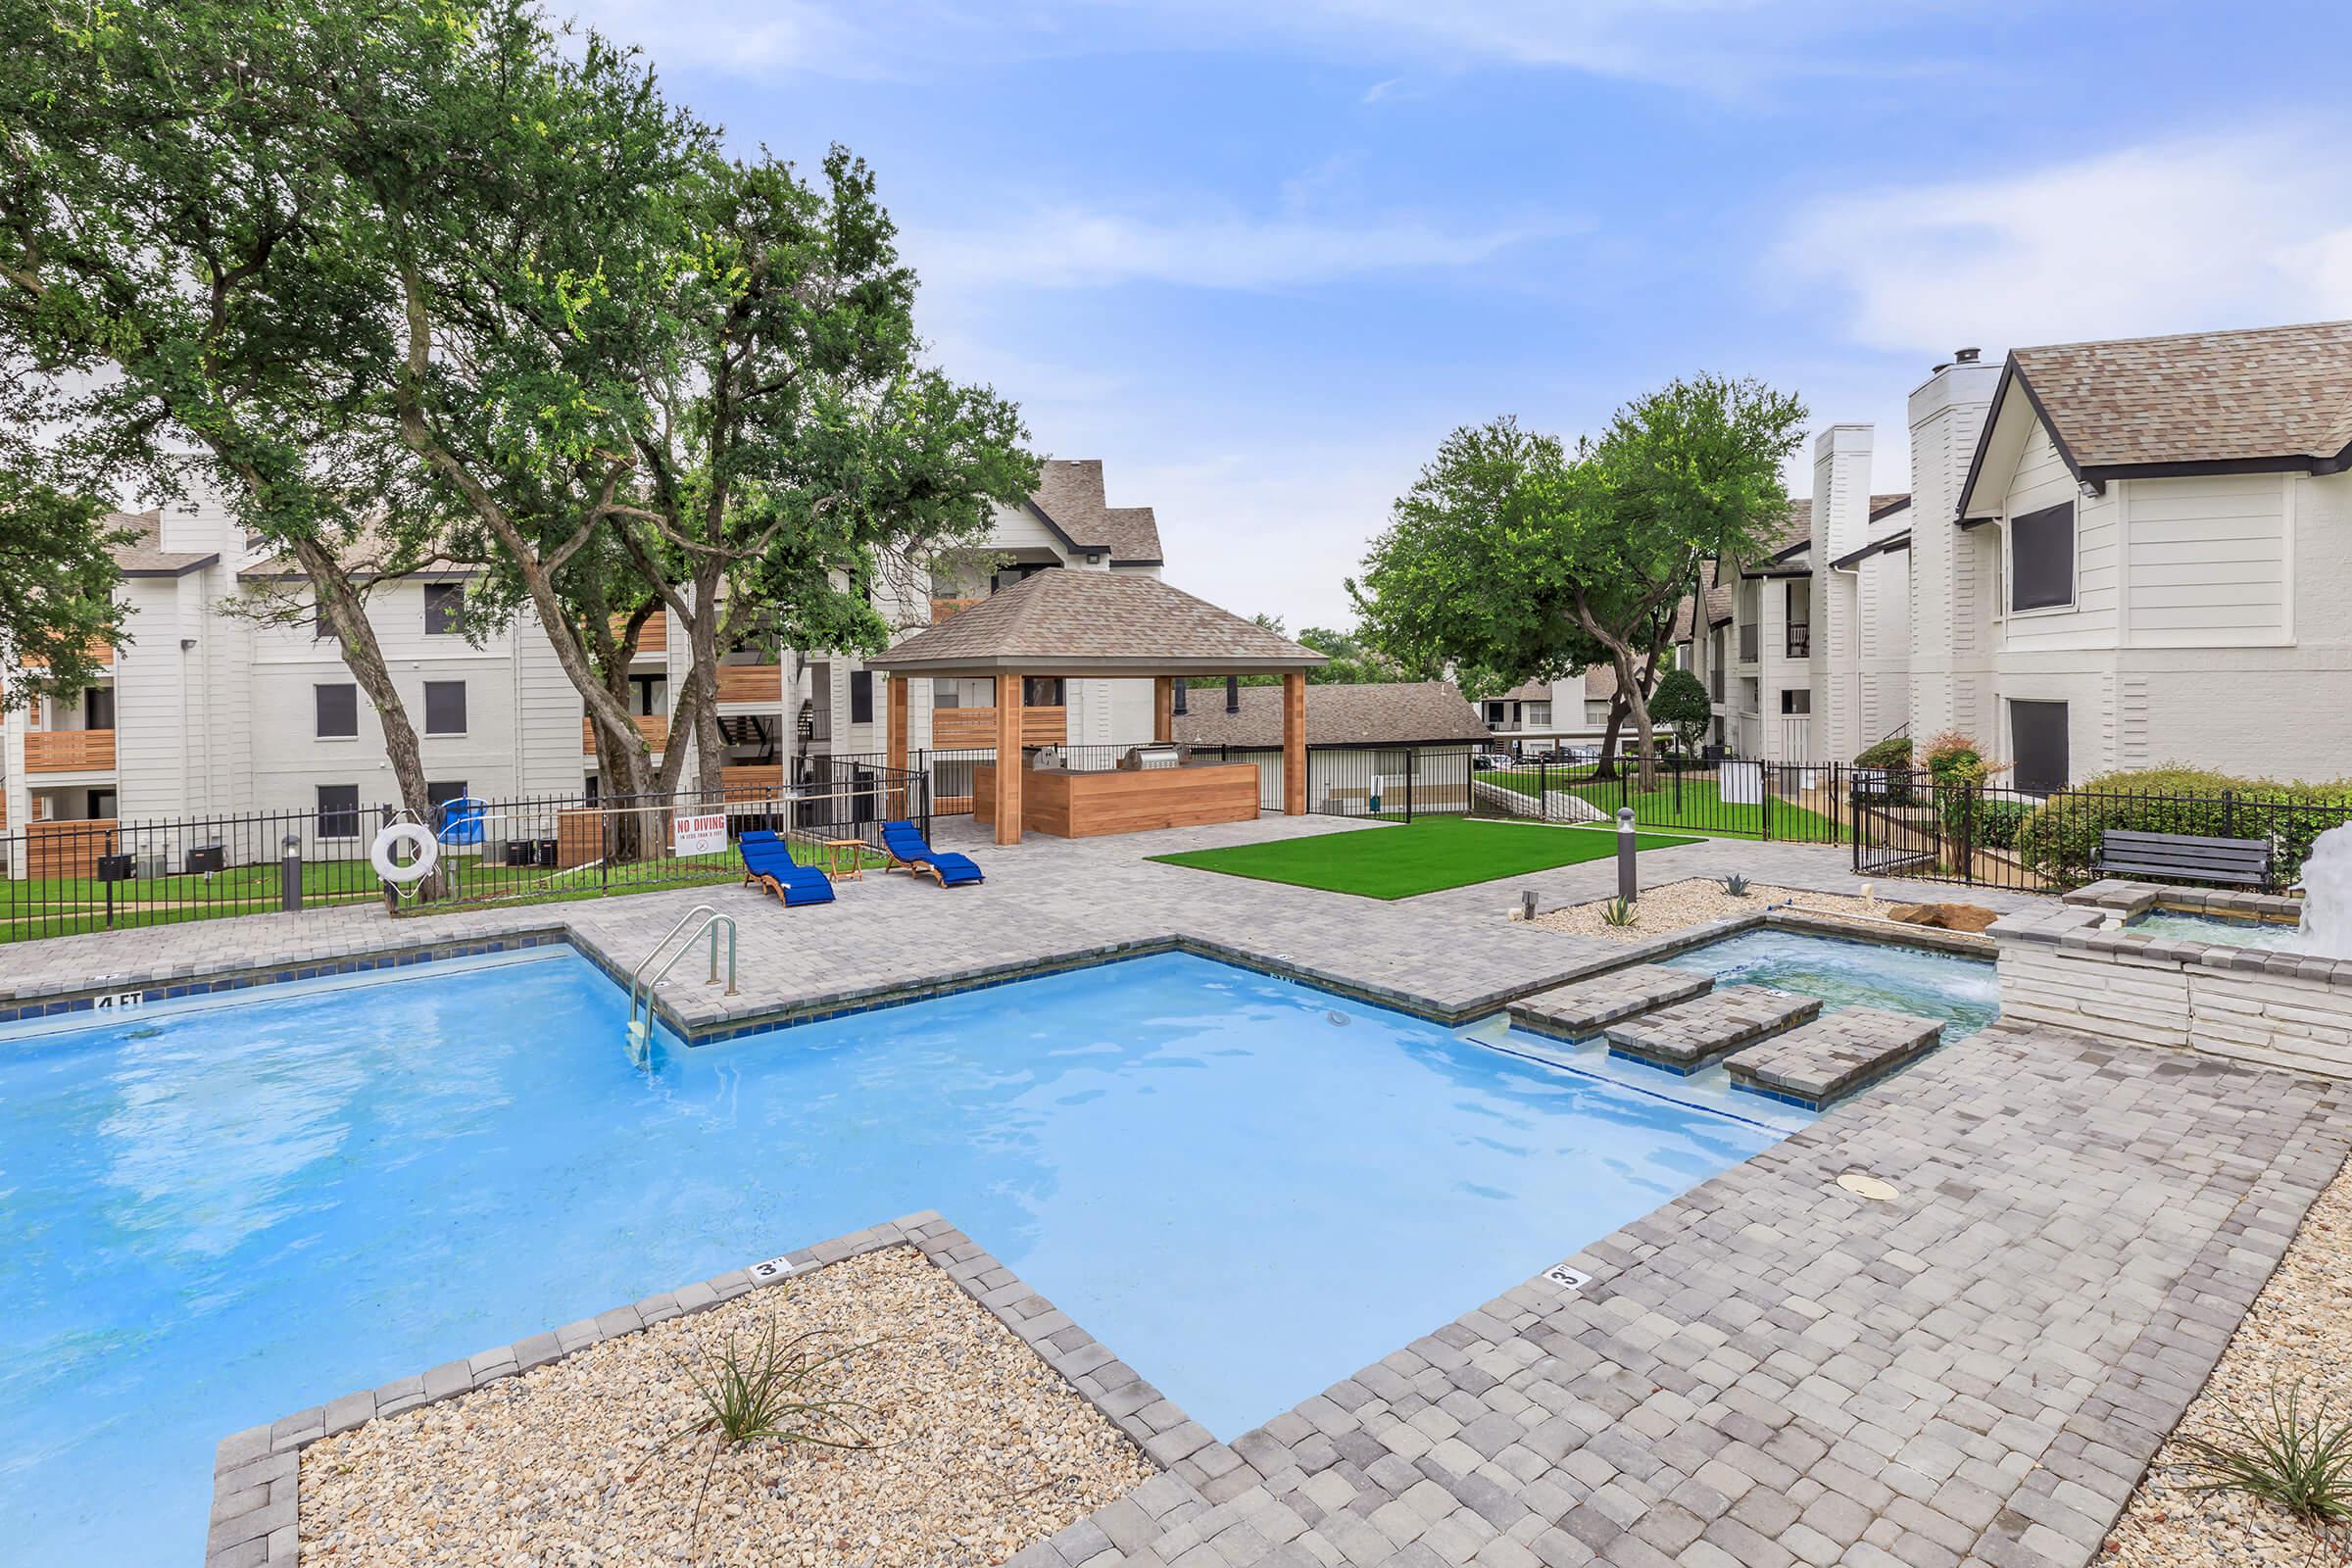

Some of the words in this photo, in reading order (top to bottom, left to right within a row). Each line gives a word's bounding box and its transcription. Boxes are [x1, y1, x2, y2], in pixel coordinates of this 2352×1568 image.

[677, 819, 690, 833] NO
[694, 815, 724, 831] DIVING
[99, 997, 112, 1007] 4
[120, 993, 141, 1005] FT
[757, 1264, 777, 1275] 3
[1550, 1272, 1579, 1285] 3
